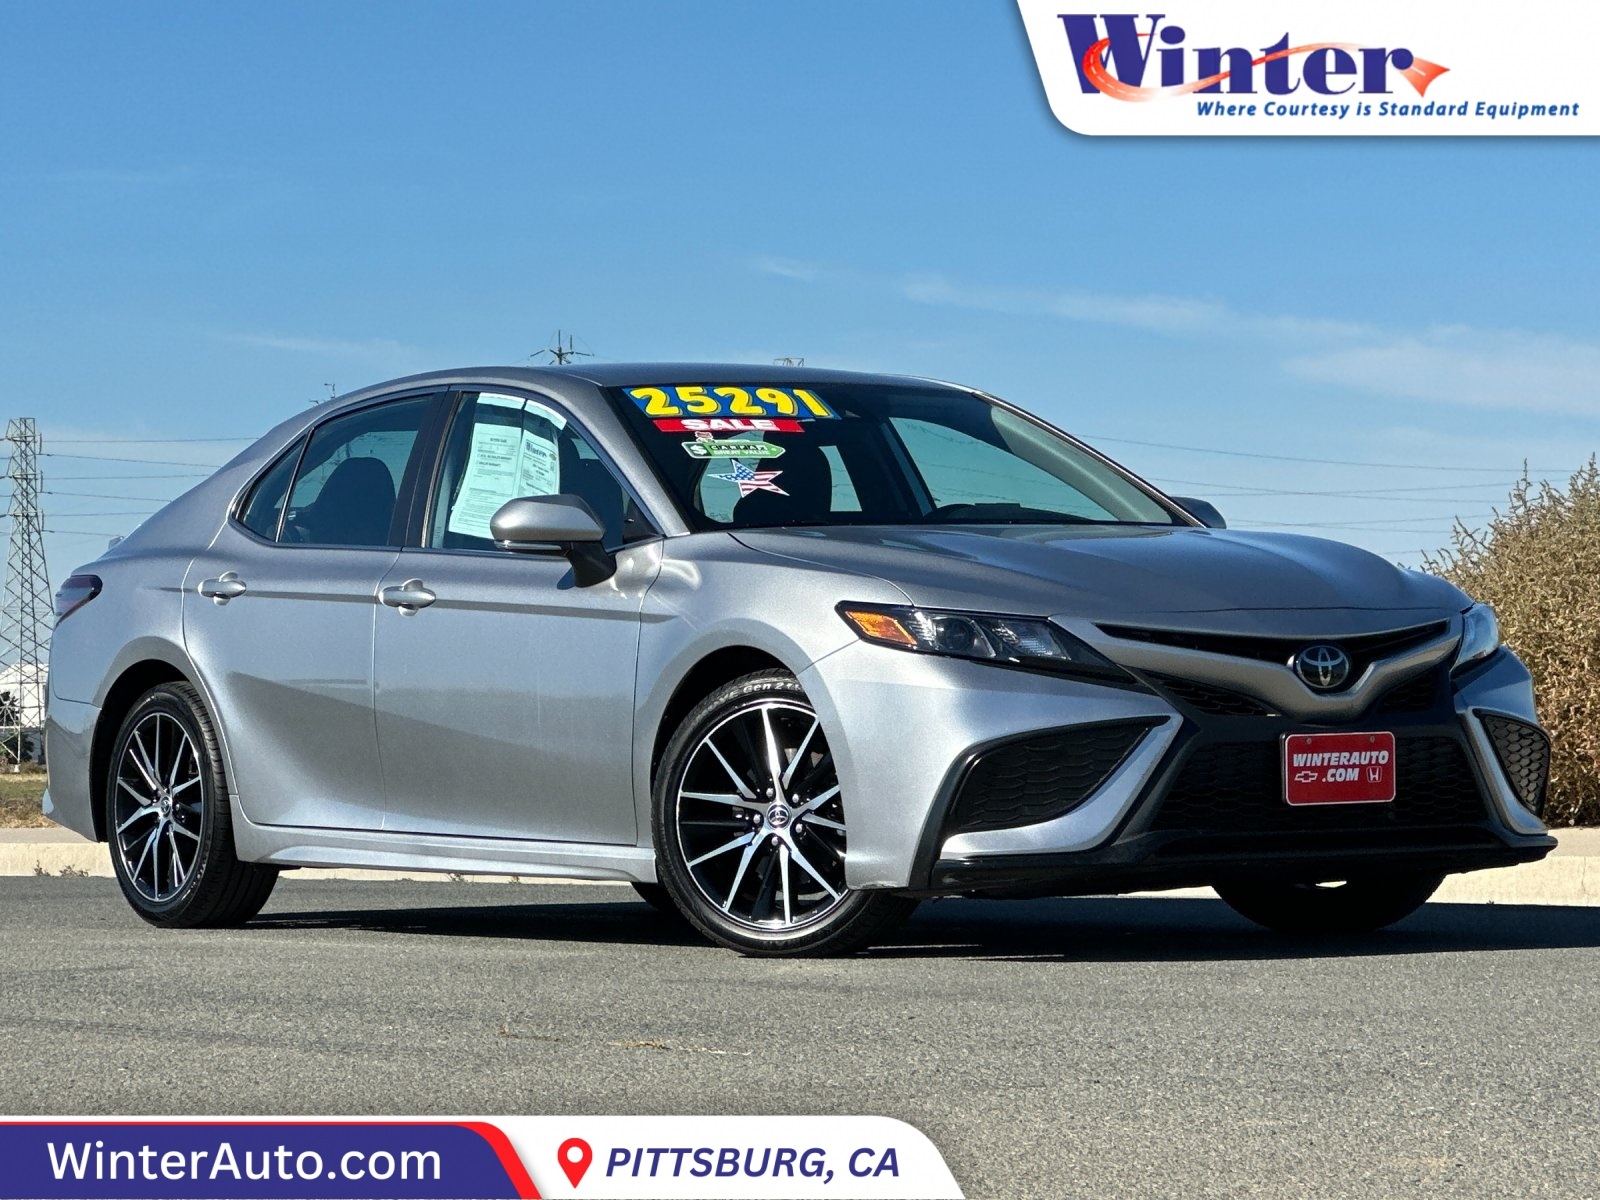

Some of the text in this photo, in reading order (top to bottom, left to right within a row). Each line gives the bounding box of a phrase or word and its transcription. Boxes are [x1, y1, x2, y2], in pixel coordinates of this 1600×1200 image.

[630, 387, 831, 417] 25291
[681, 419, 780, 430] SALE
[1293, 750, 1389, 767] WINTERAUTO
[1321, 768, 1360, 783] .COM
